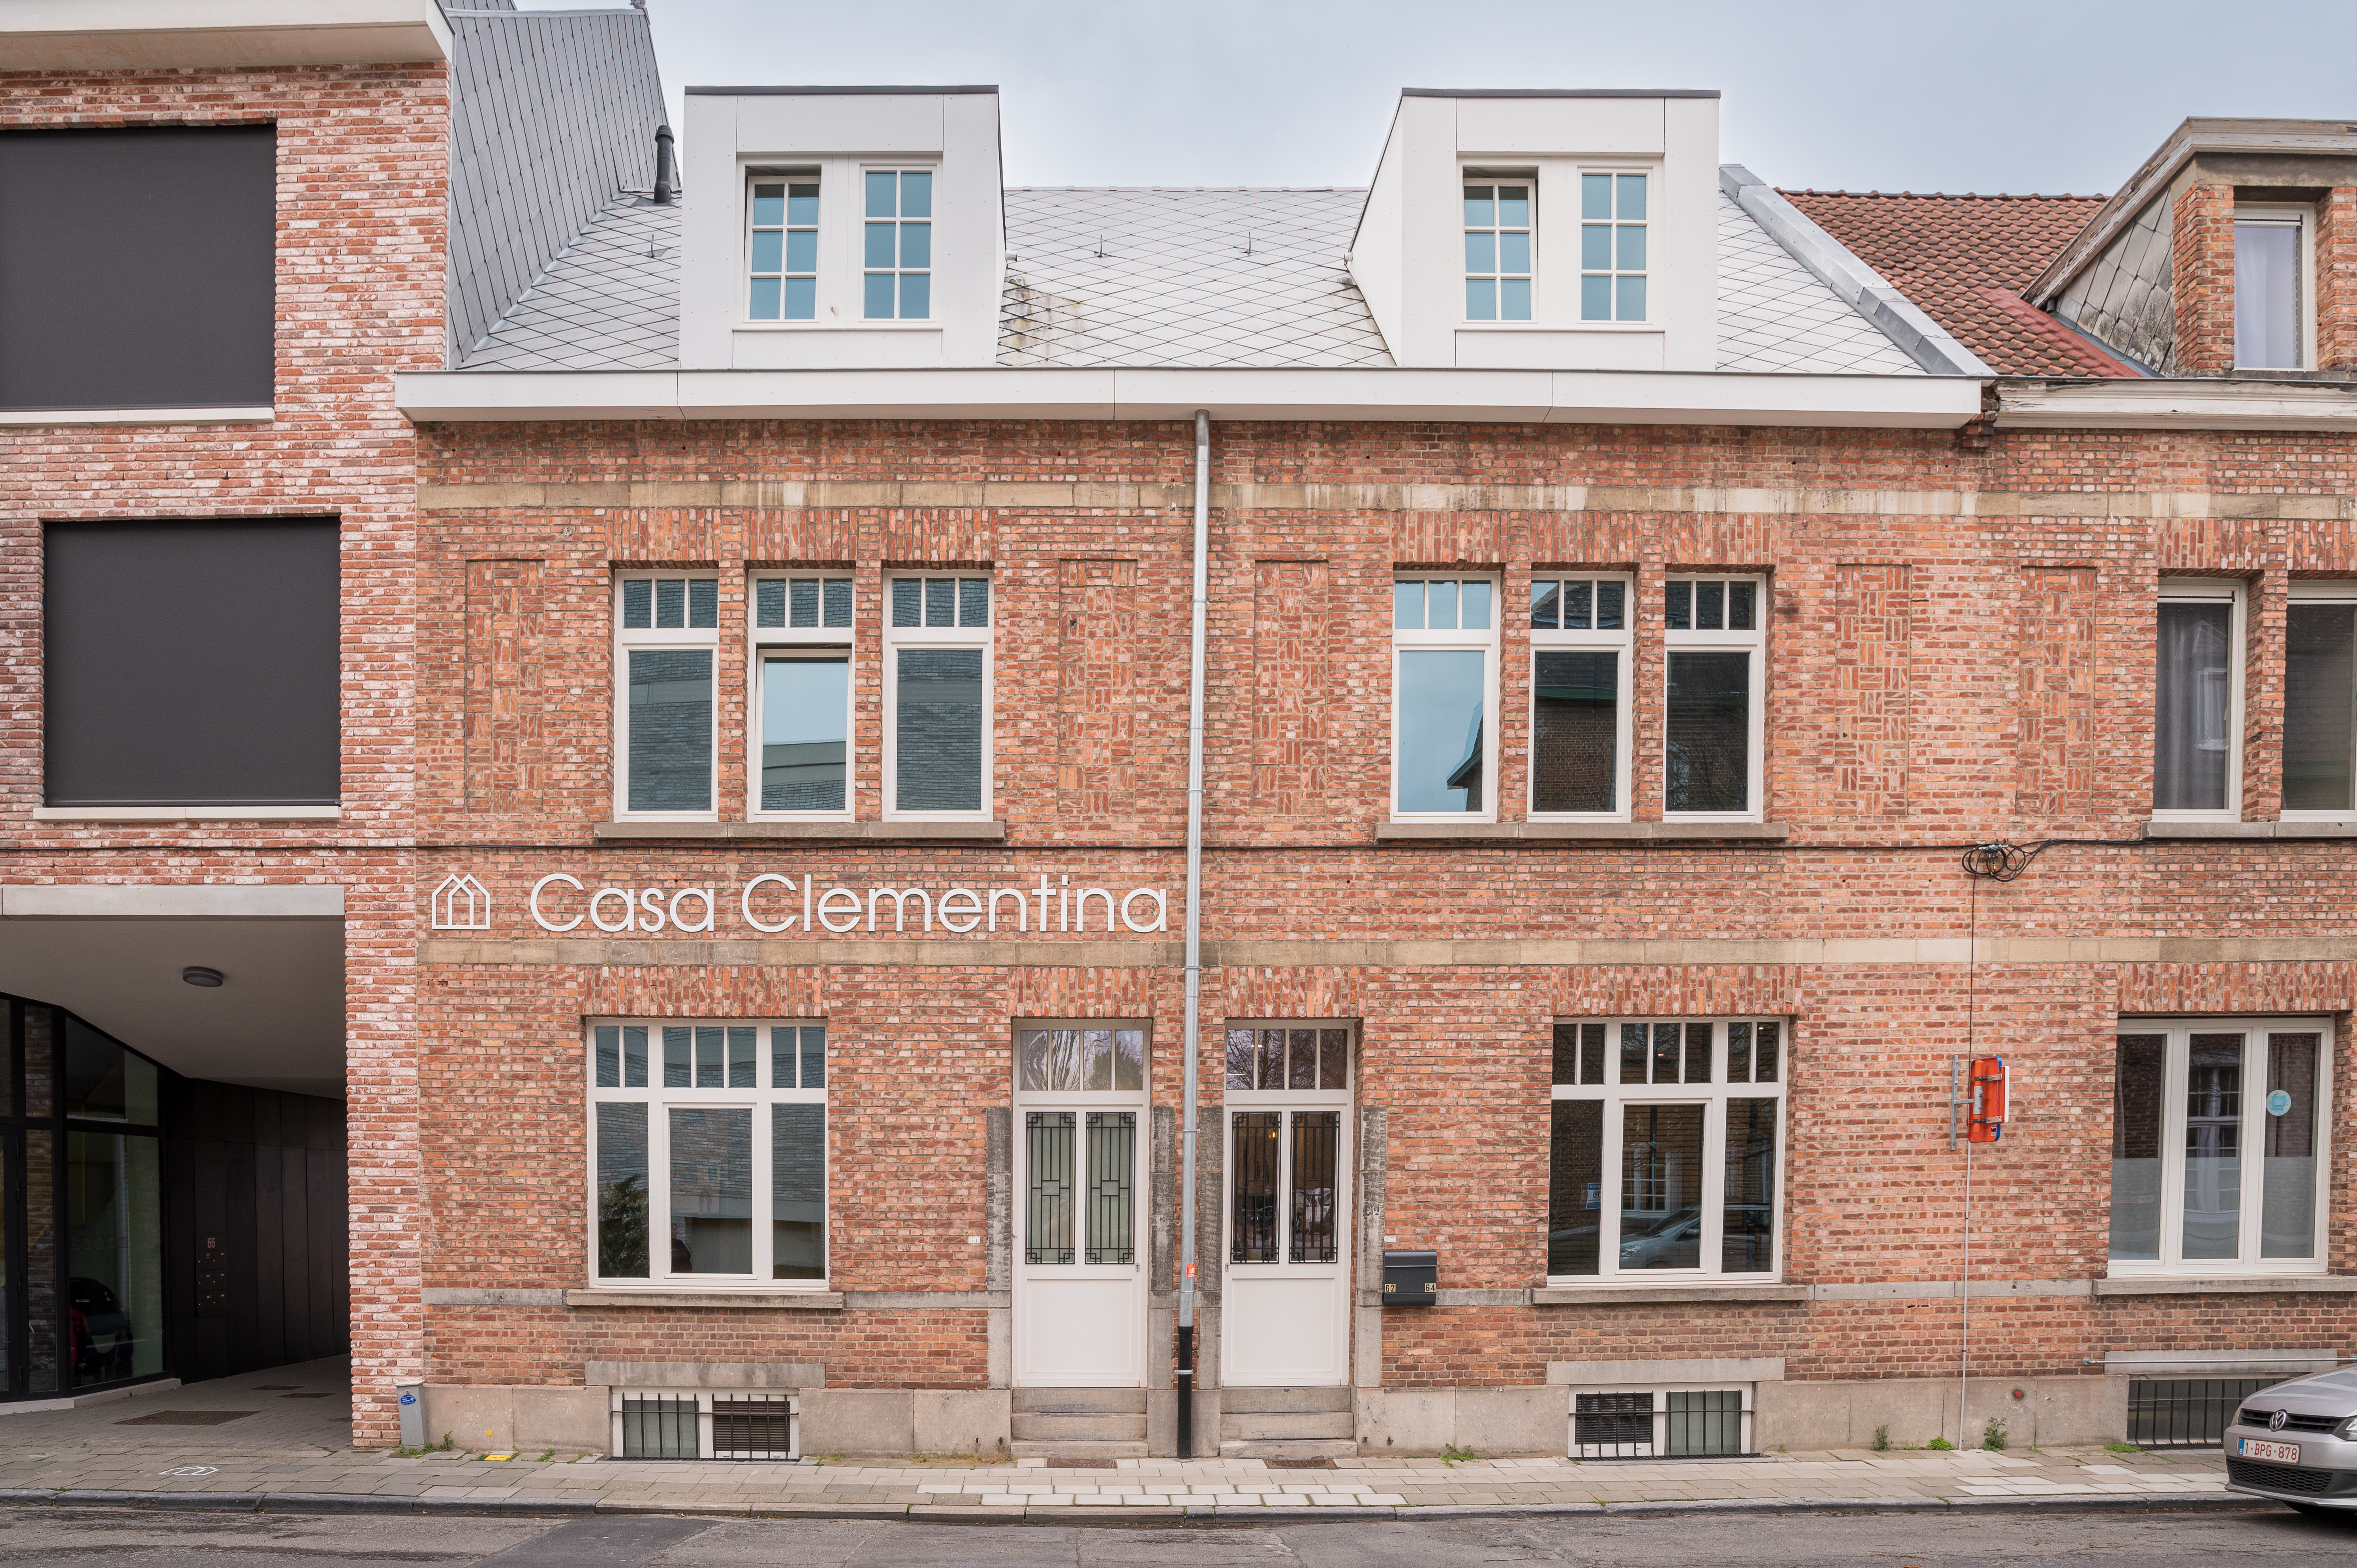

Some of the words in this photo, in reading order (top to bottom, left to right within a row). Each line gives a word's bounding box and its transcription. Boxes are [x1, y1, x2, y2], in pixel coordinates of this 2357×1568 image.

[530, 873, 714, 932] Casa
[741, 873, 1167, 933] Clementina
[208, 1237, 215, 1248] 66
[2245, 1442, 2297, 1461] 1-BPG-878
